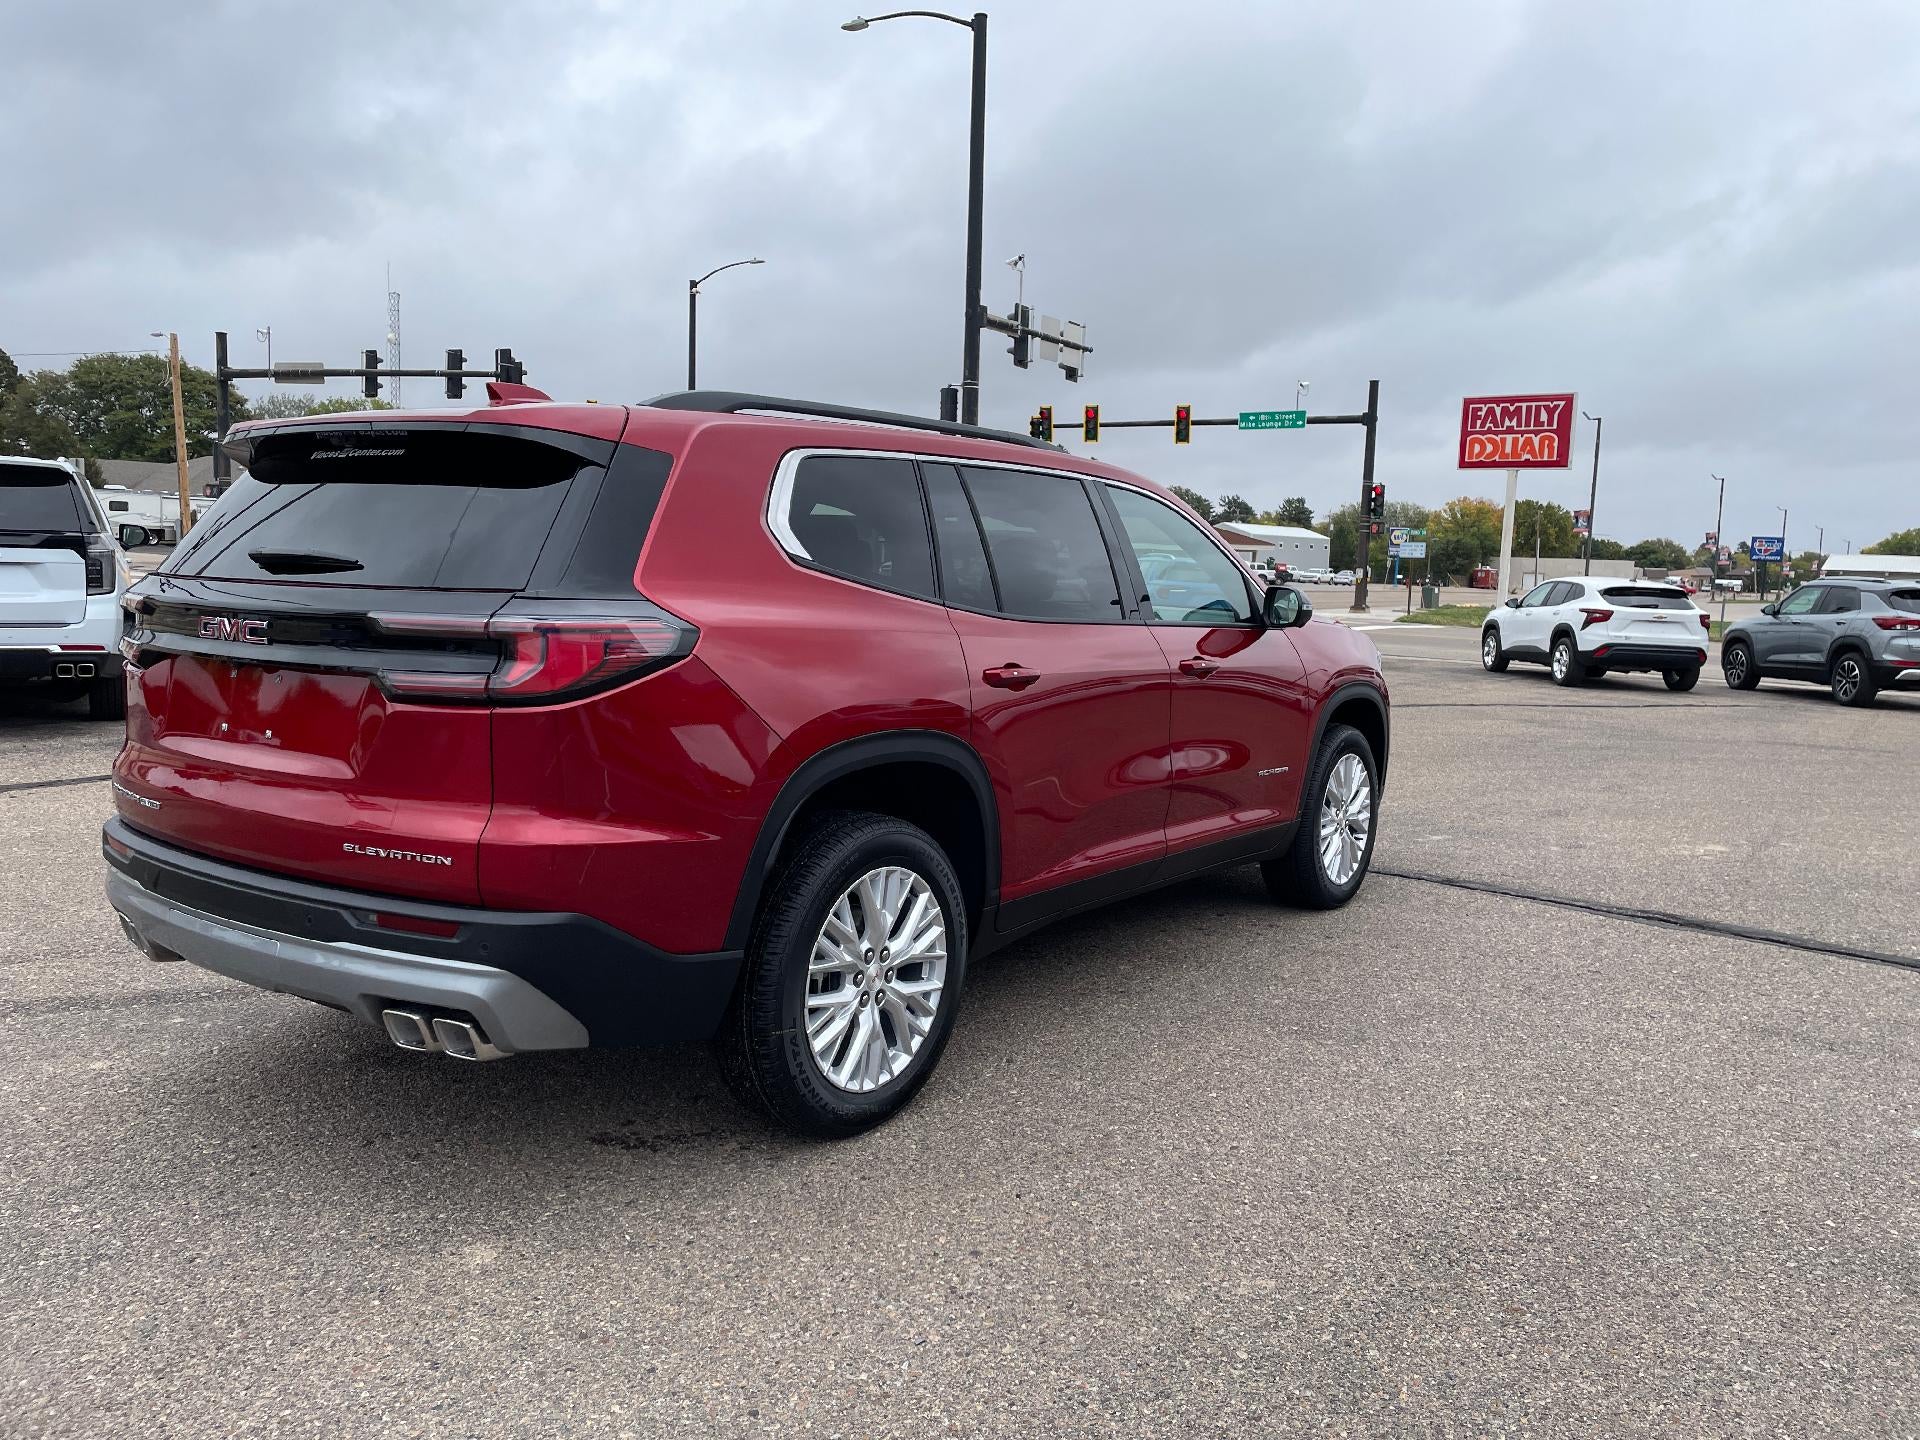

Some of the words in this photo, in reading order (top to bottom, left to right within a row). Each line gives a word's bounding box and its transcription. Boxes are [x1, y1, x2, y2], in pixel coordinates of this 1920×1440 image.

[1468, 401, 1566, 431] FAMILY
[1465, 432, 1559, 462] DOLLAR
[198, 615, 270, 645] GMC
[342, 842, 453, 866] ELEVATION
